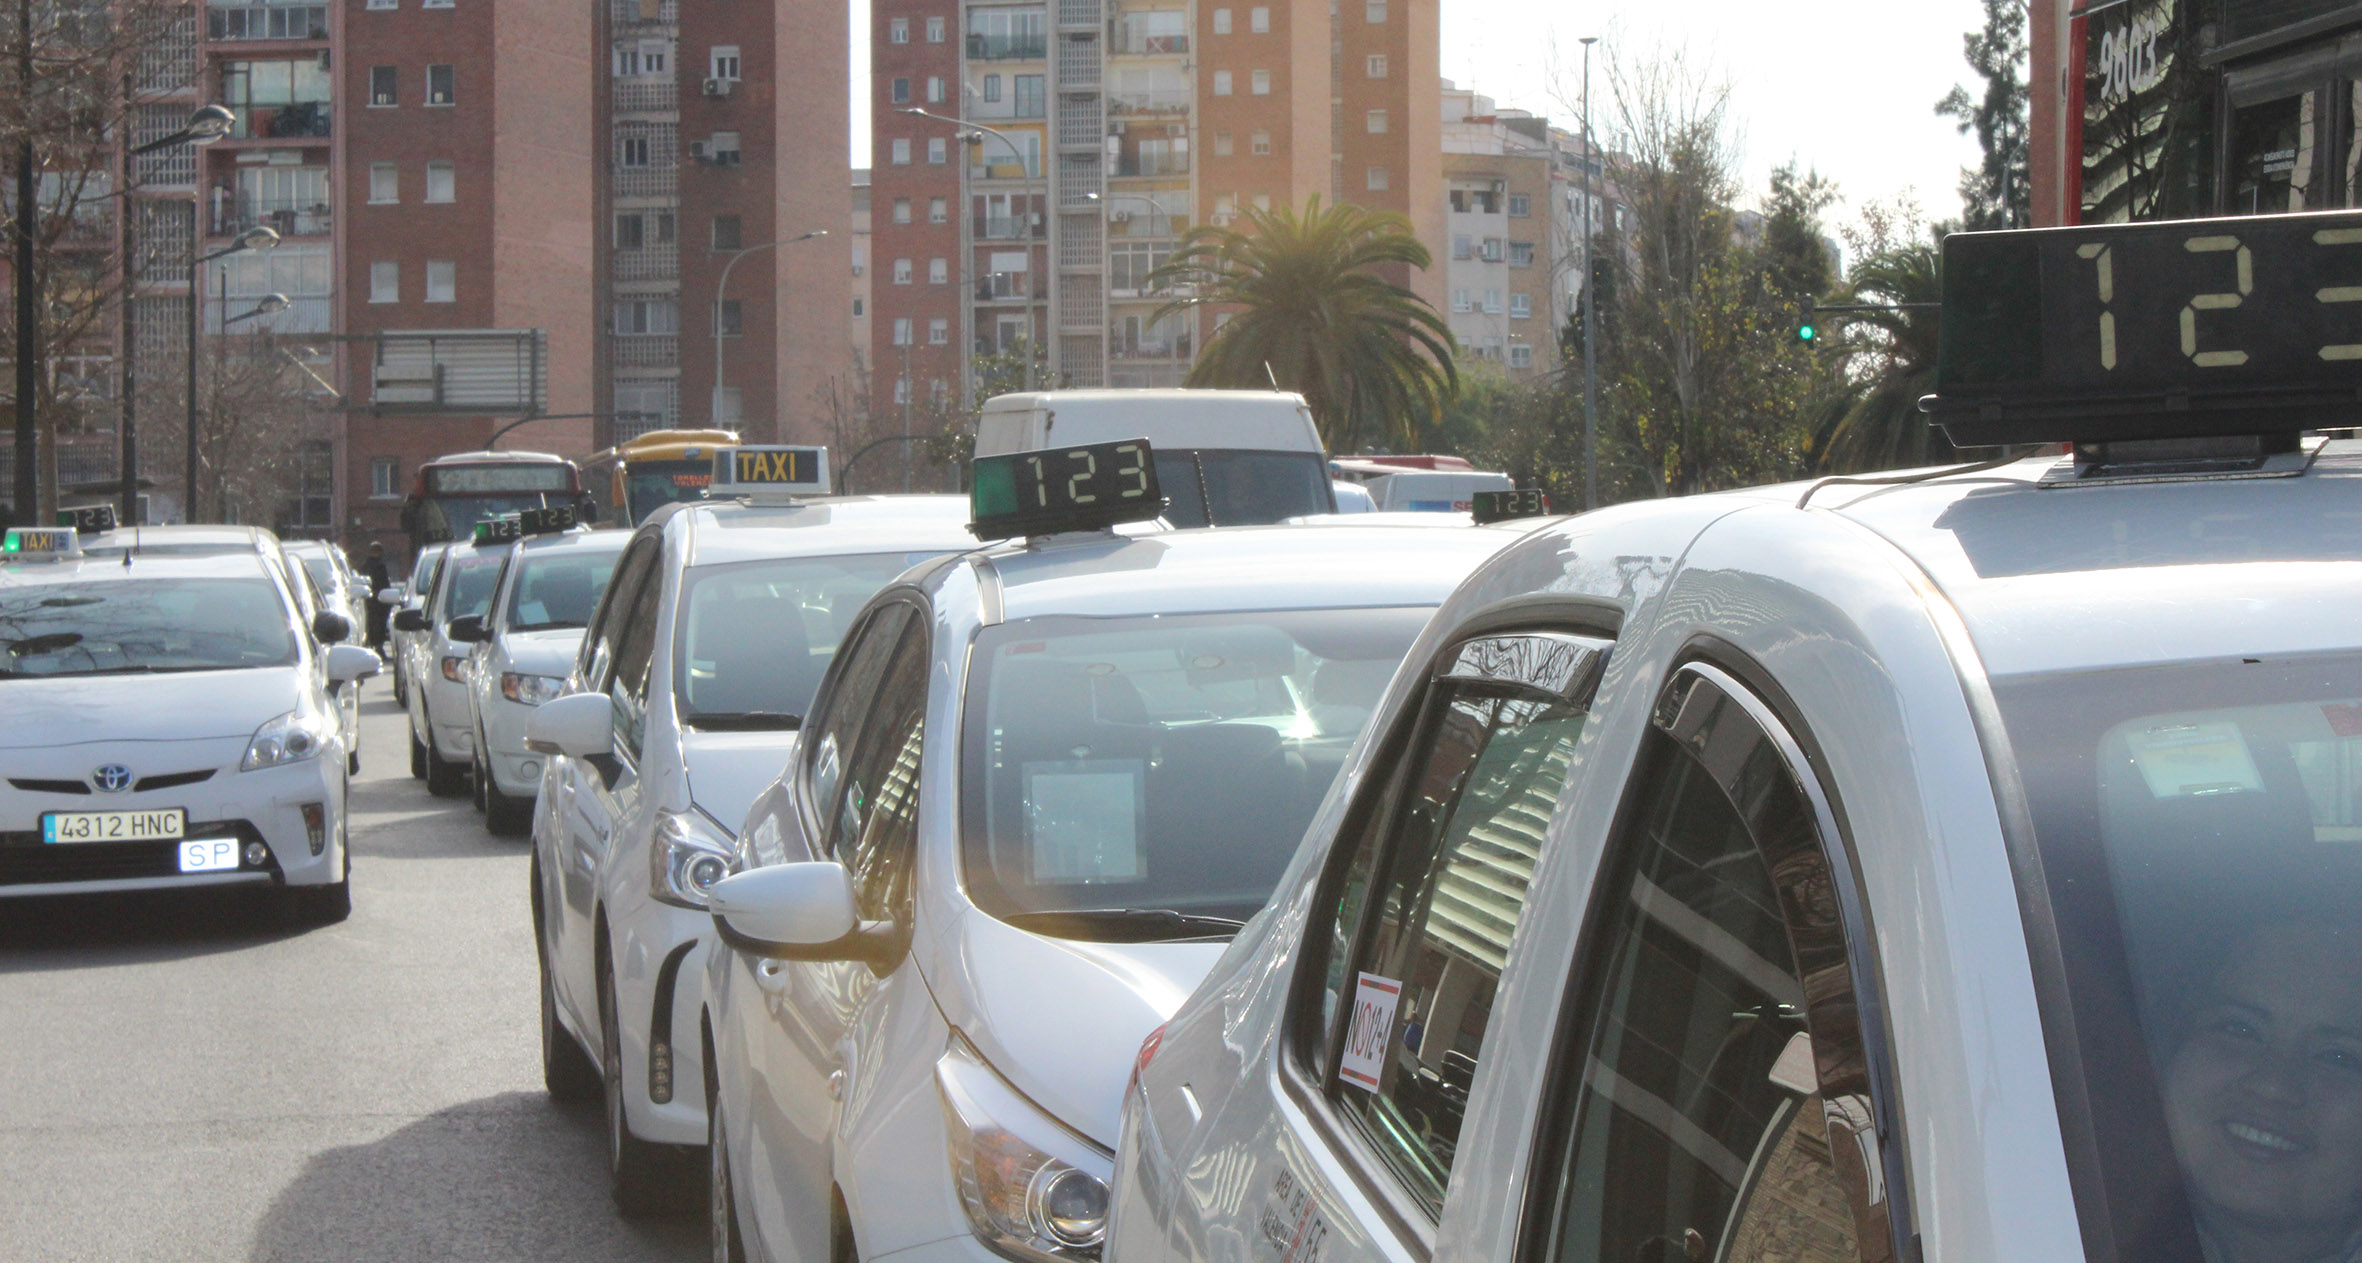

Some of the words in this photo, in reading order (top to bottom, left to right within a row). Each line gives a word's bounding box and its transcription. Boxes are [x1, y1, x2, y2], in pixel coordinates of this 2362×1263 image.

[2099, 18, 2157, 100] 9603
[737, 452, 796, 481] TAXI
[1026, 444, 1147, 507] 123
[1492, 491, 1539, 514] 123
[72, 507, 112, 529] 123
[489, 520, 522, 537] 123
[536, 510, 574, 527] 123
[22, 531, 54, 552] TAXI
[61, 814, 123, 839] 4312
[131, 813, 178, 837] HNC
